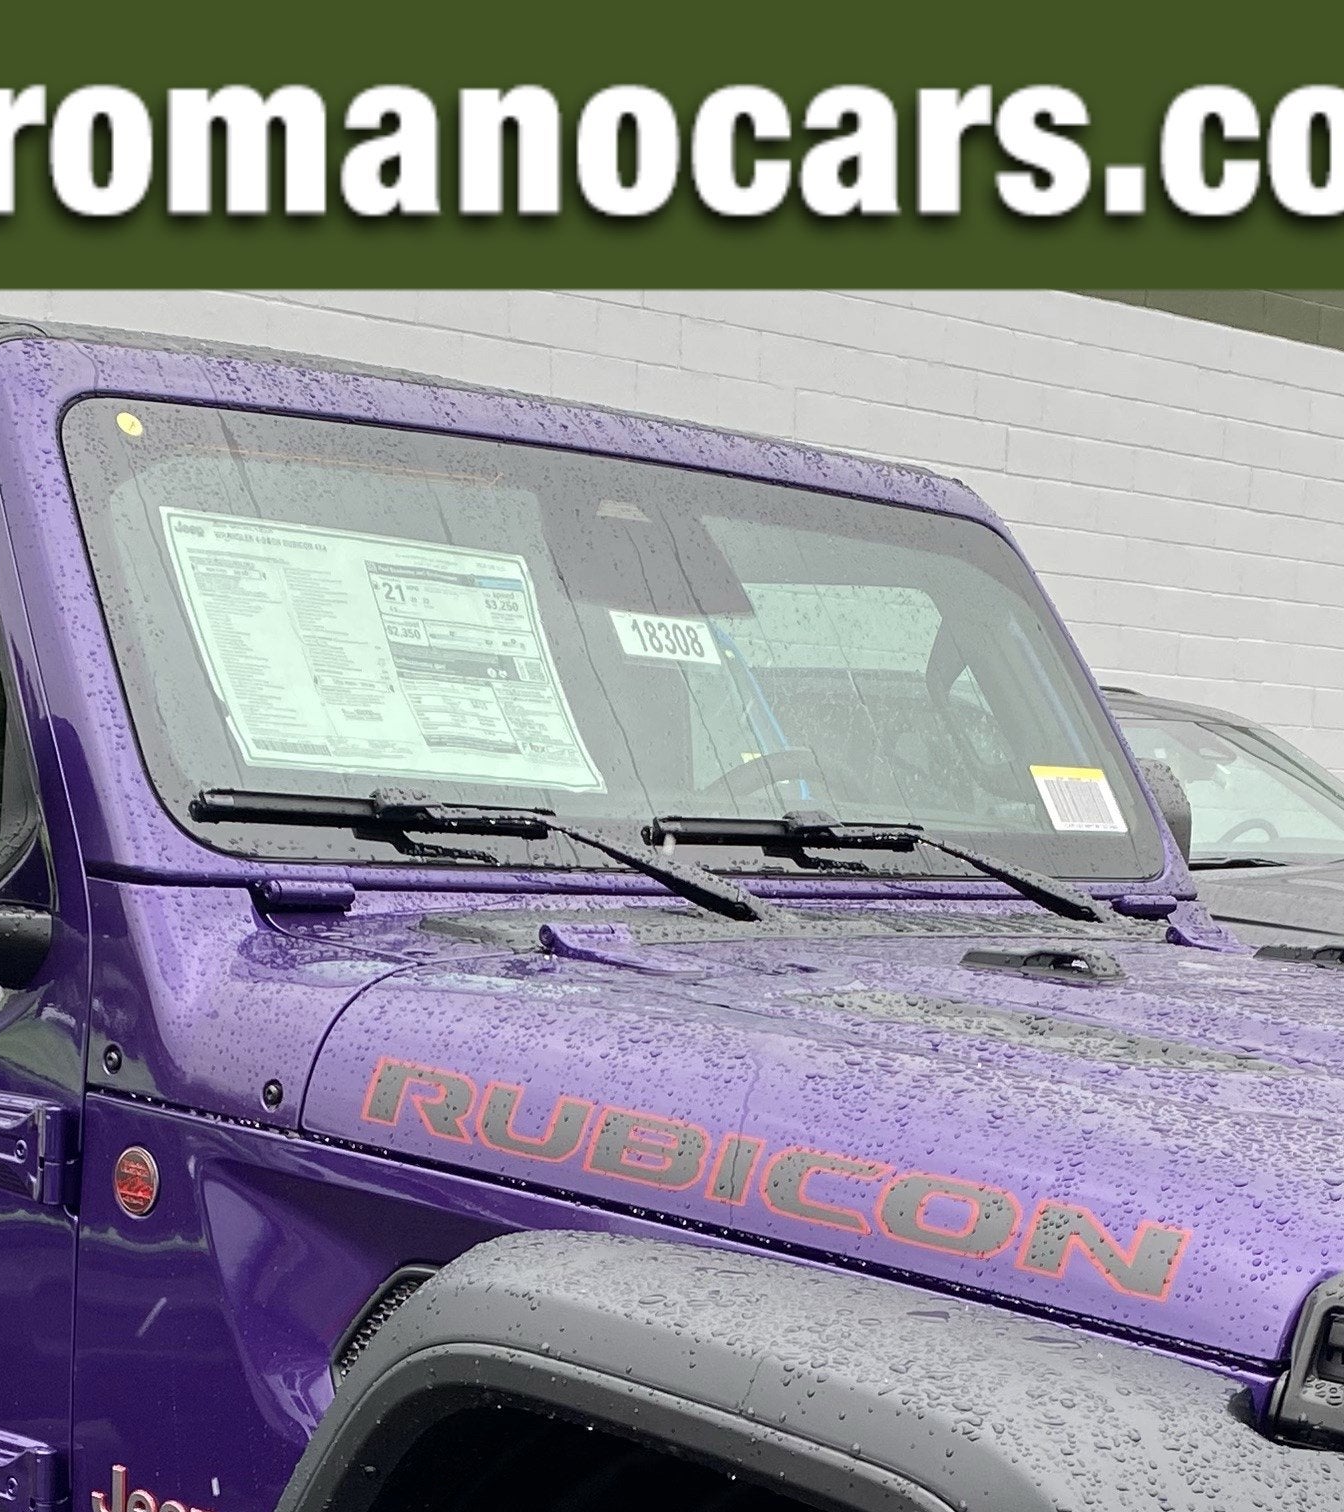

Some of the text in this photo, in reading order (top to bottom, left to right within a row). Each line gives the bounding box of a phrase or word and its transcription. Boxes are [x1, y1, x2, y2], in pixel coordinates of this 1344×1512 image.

[382, 582, 405, 602] 21
[631, 619, 705, 658] 18308
[361, 1056, 1194, 1302] RUBICON
